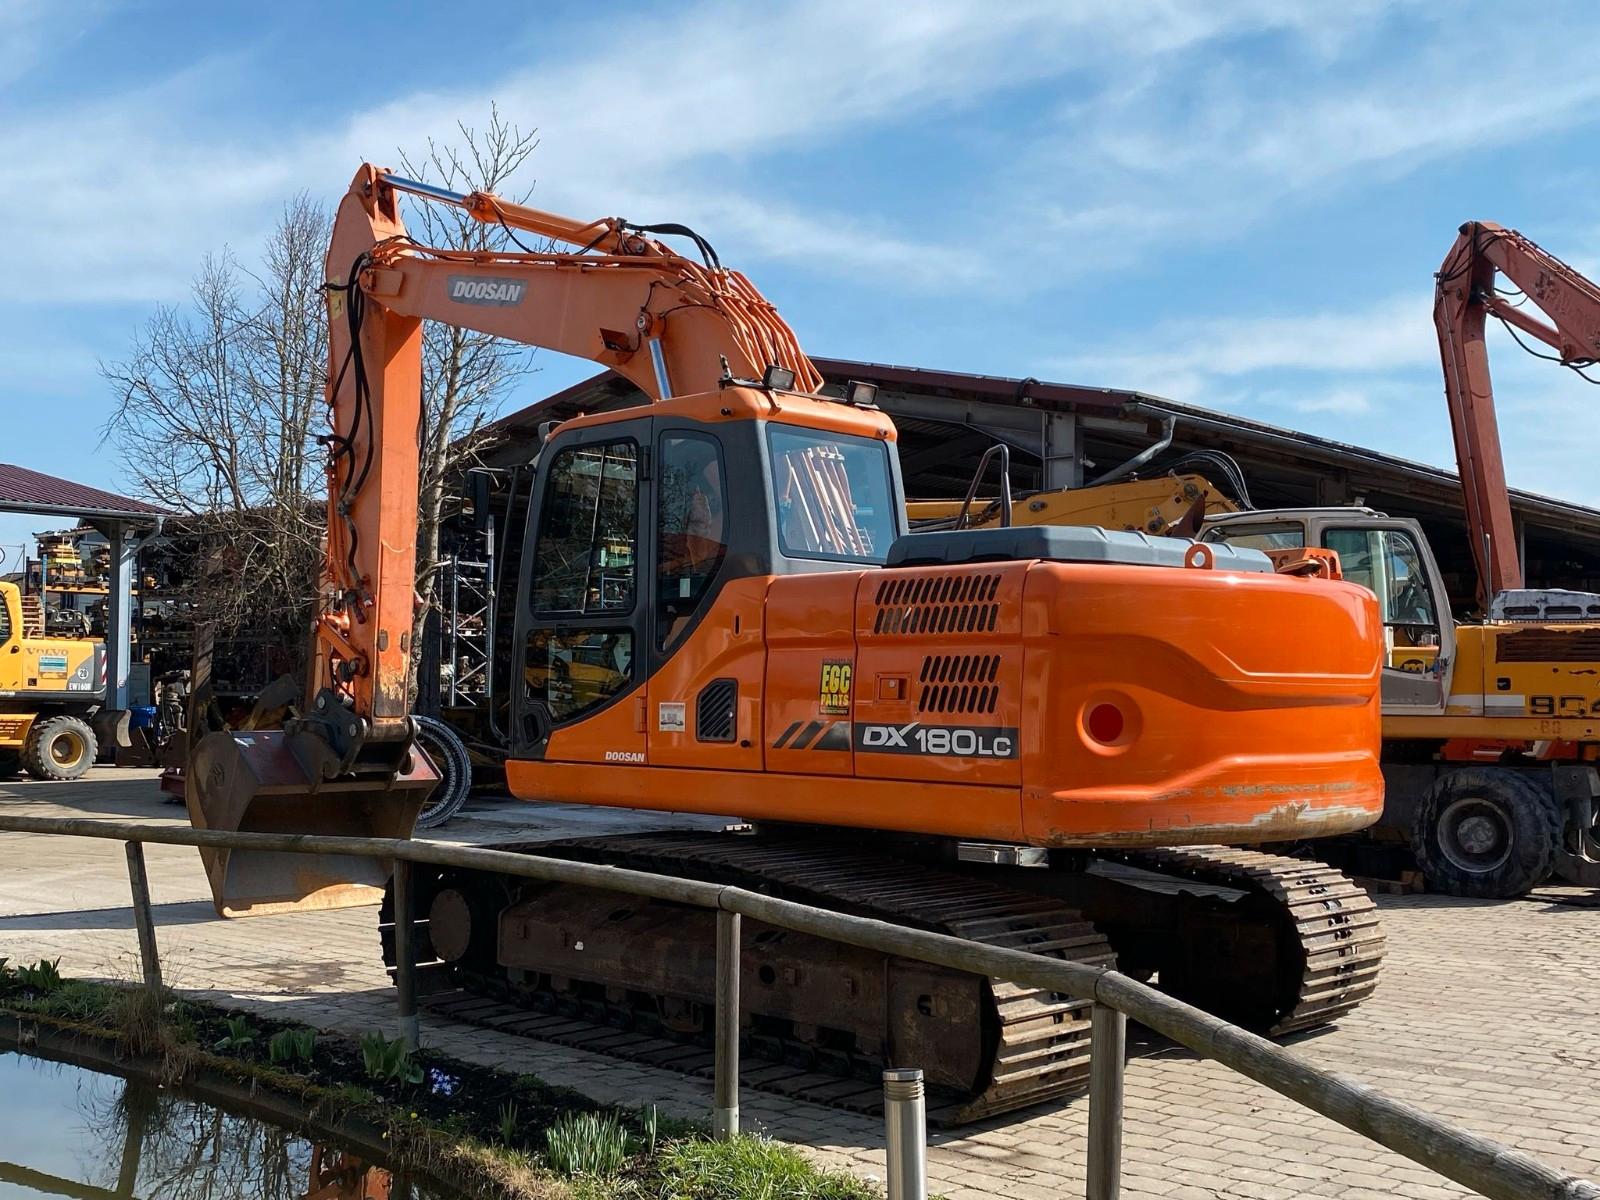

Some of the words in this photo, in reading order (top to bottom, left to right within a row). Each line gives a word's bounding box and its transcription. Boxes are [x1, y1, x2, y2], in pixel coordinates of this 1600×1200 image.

[453, 281, 521, 301] DOOSAN
[26, 647, 69, 656] VOLVO
[821, 664, 851, 694] EGC
[820, 693, 849, 706] PARTS
[605, 751, 645, 762] DOOSAN
